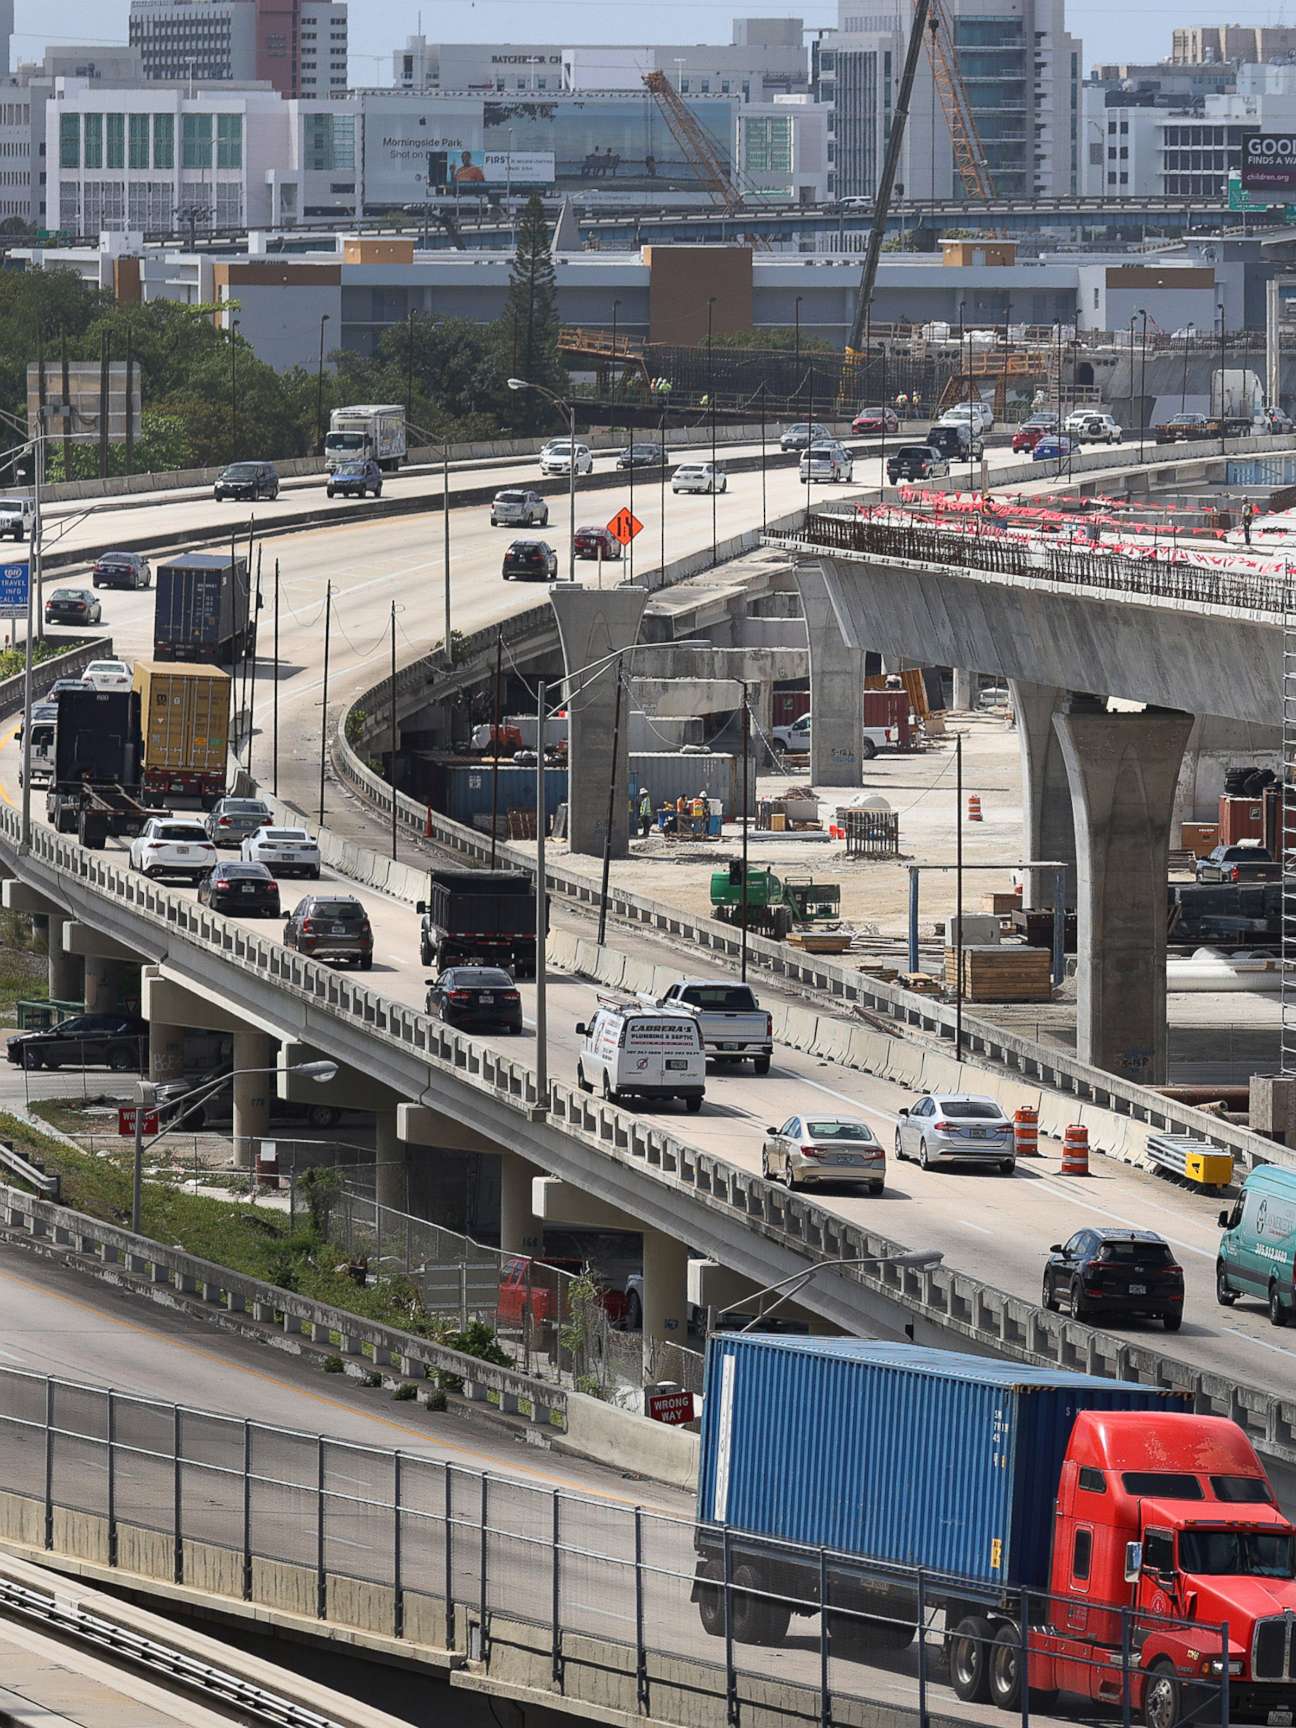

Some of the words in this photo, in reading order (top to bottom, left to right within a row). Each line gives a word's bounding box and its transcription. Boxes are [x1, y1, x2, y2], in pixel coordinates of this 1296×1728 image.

[383, 137, 440, 149] Morningside
[441, 137, 463, 148] Park
[1248, 155, 1274, 165] FINDS
[1276, 156, 1283, 164] A
[1247, 173, 1290, 183] children.org
[1, 579, 26, 587] TRAVEL
[631, 1025, 693, 1033] CABRERA'S
[123, 1111, 154, 1120] WRG
[129, 1122, 148, 1131] WY
[654, 1397, 689, 1411] WRONG
[661, 1410, 683, 1421] WAY
